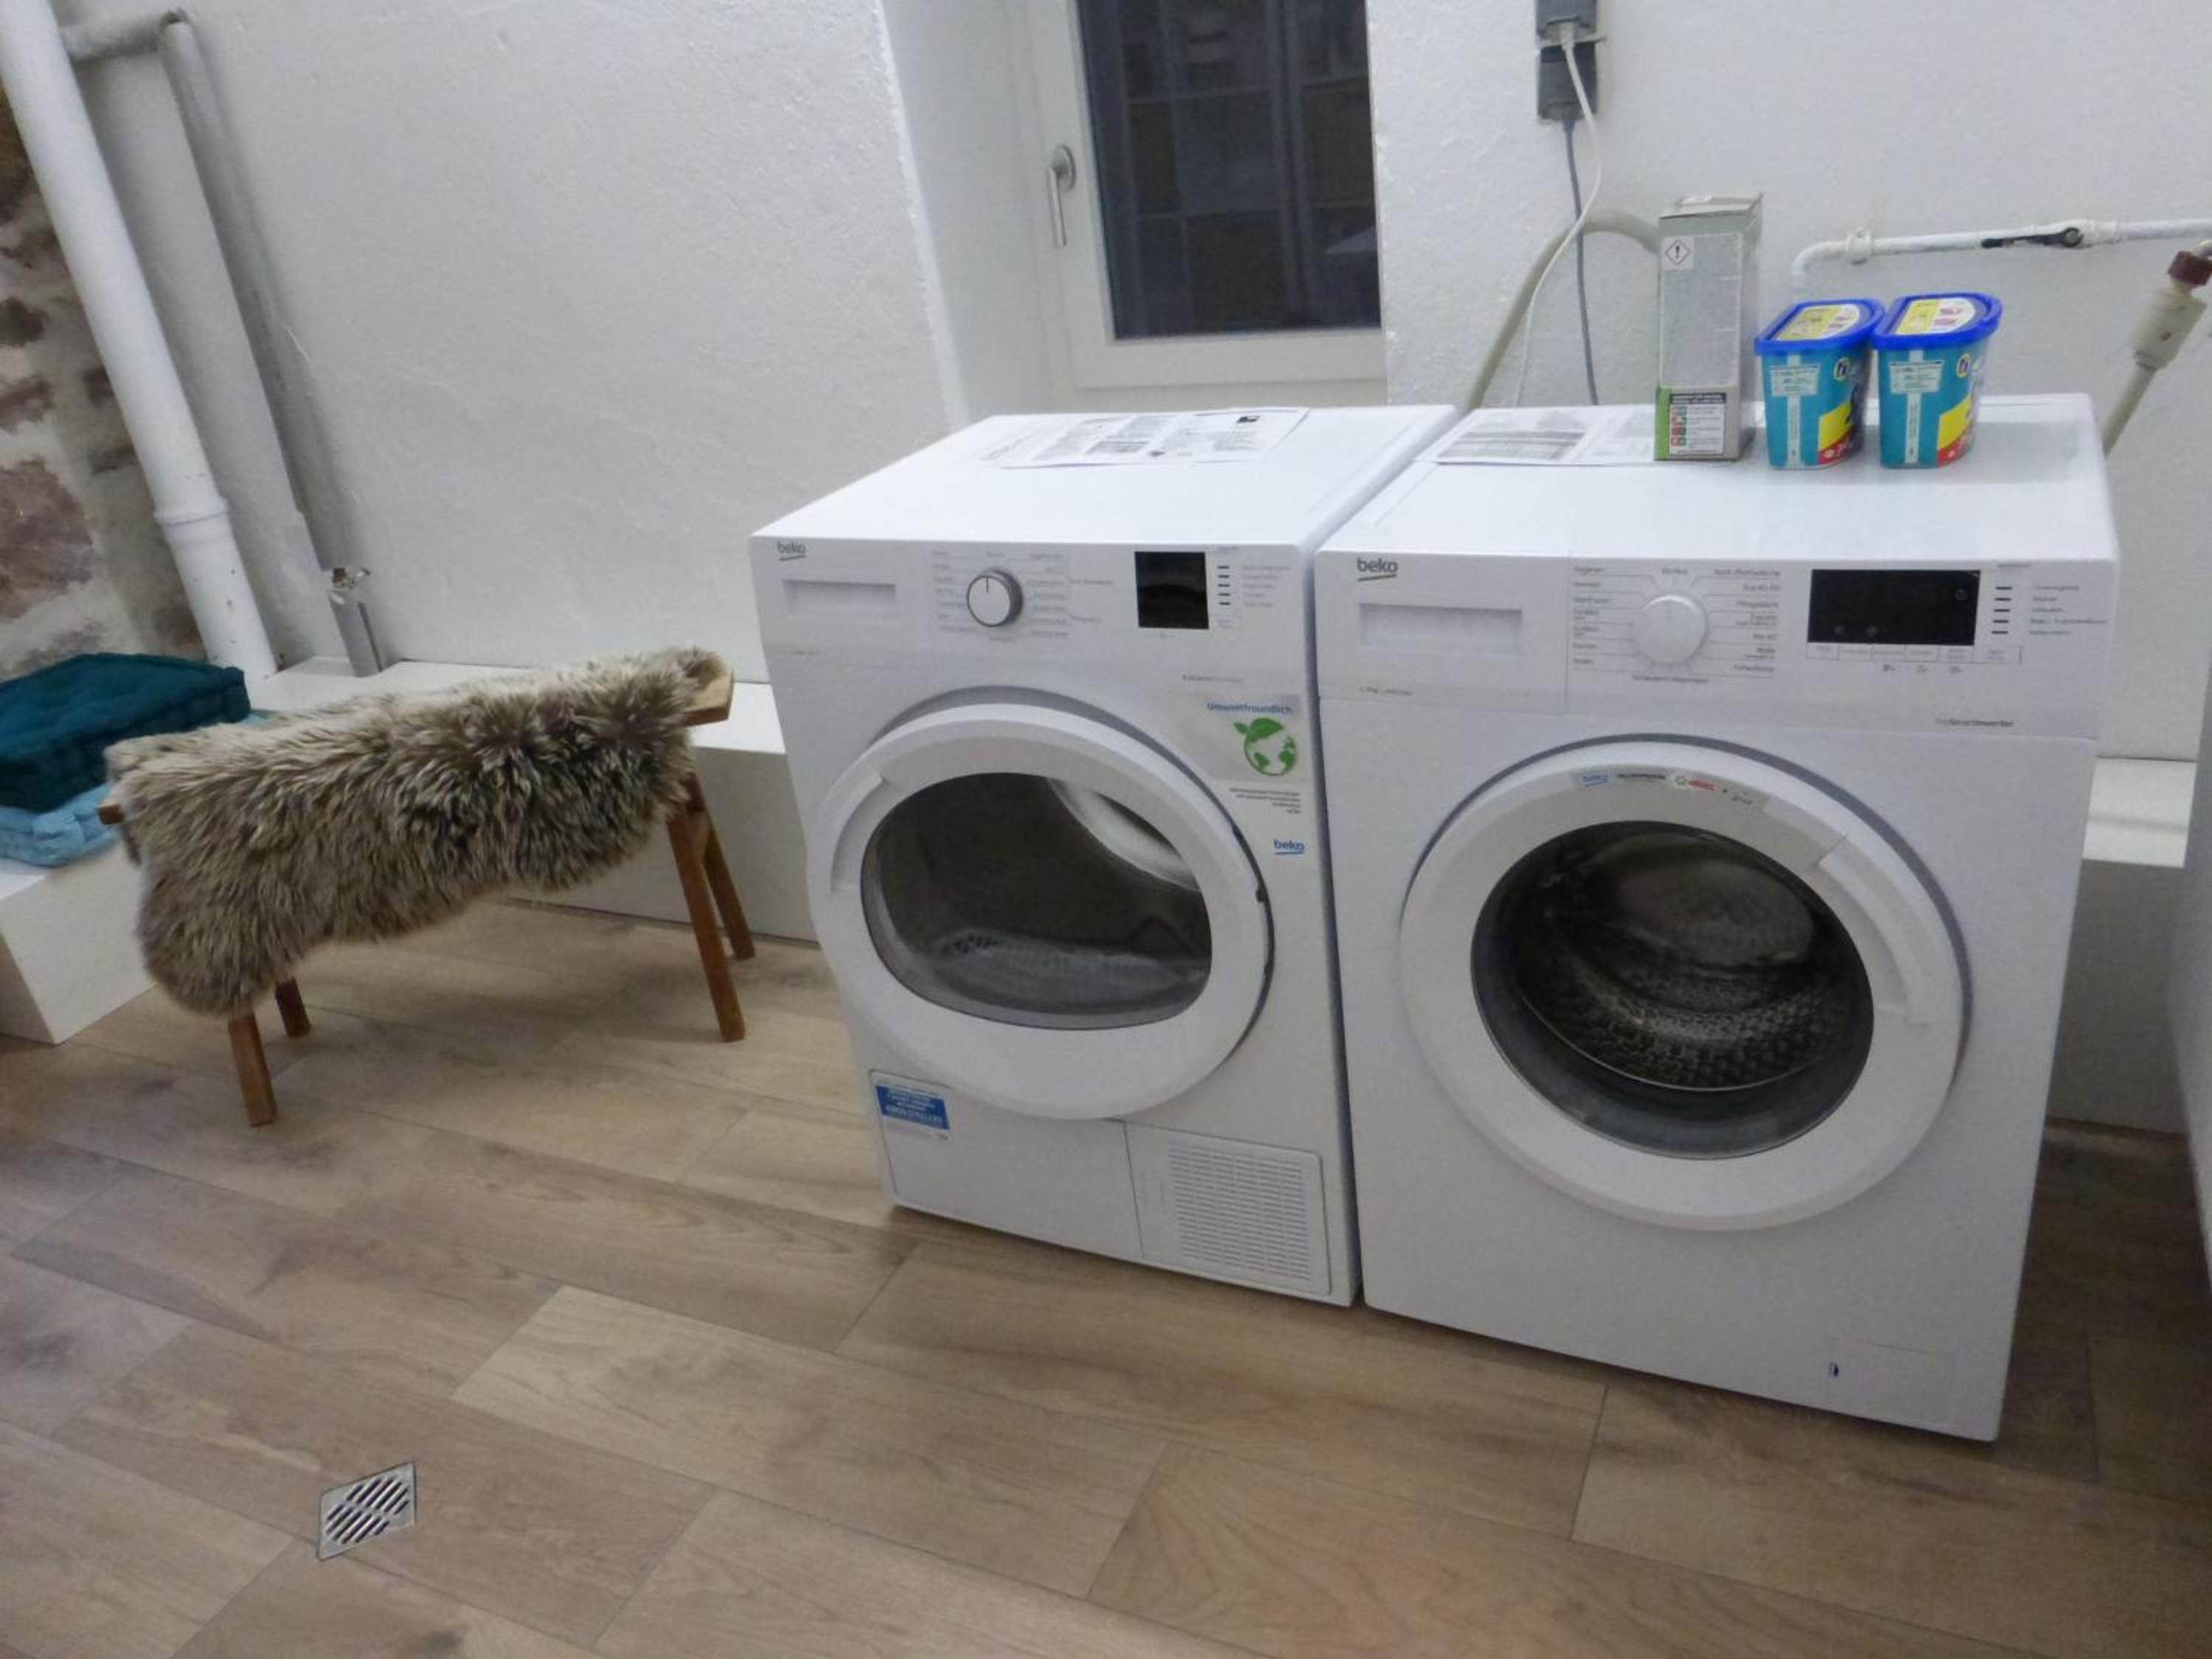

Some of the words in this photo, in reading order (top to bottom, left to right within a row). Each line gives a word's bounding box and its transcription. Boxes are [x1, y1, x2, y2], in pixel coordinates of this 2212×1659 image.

[777, 541, 806, 554] beko
[1357, 557, 1398, 573] beko
[1274, 839, 1304, 850] beko
